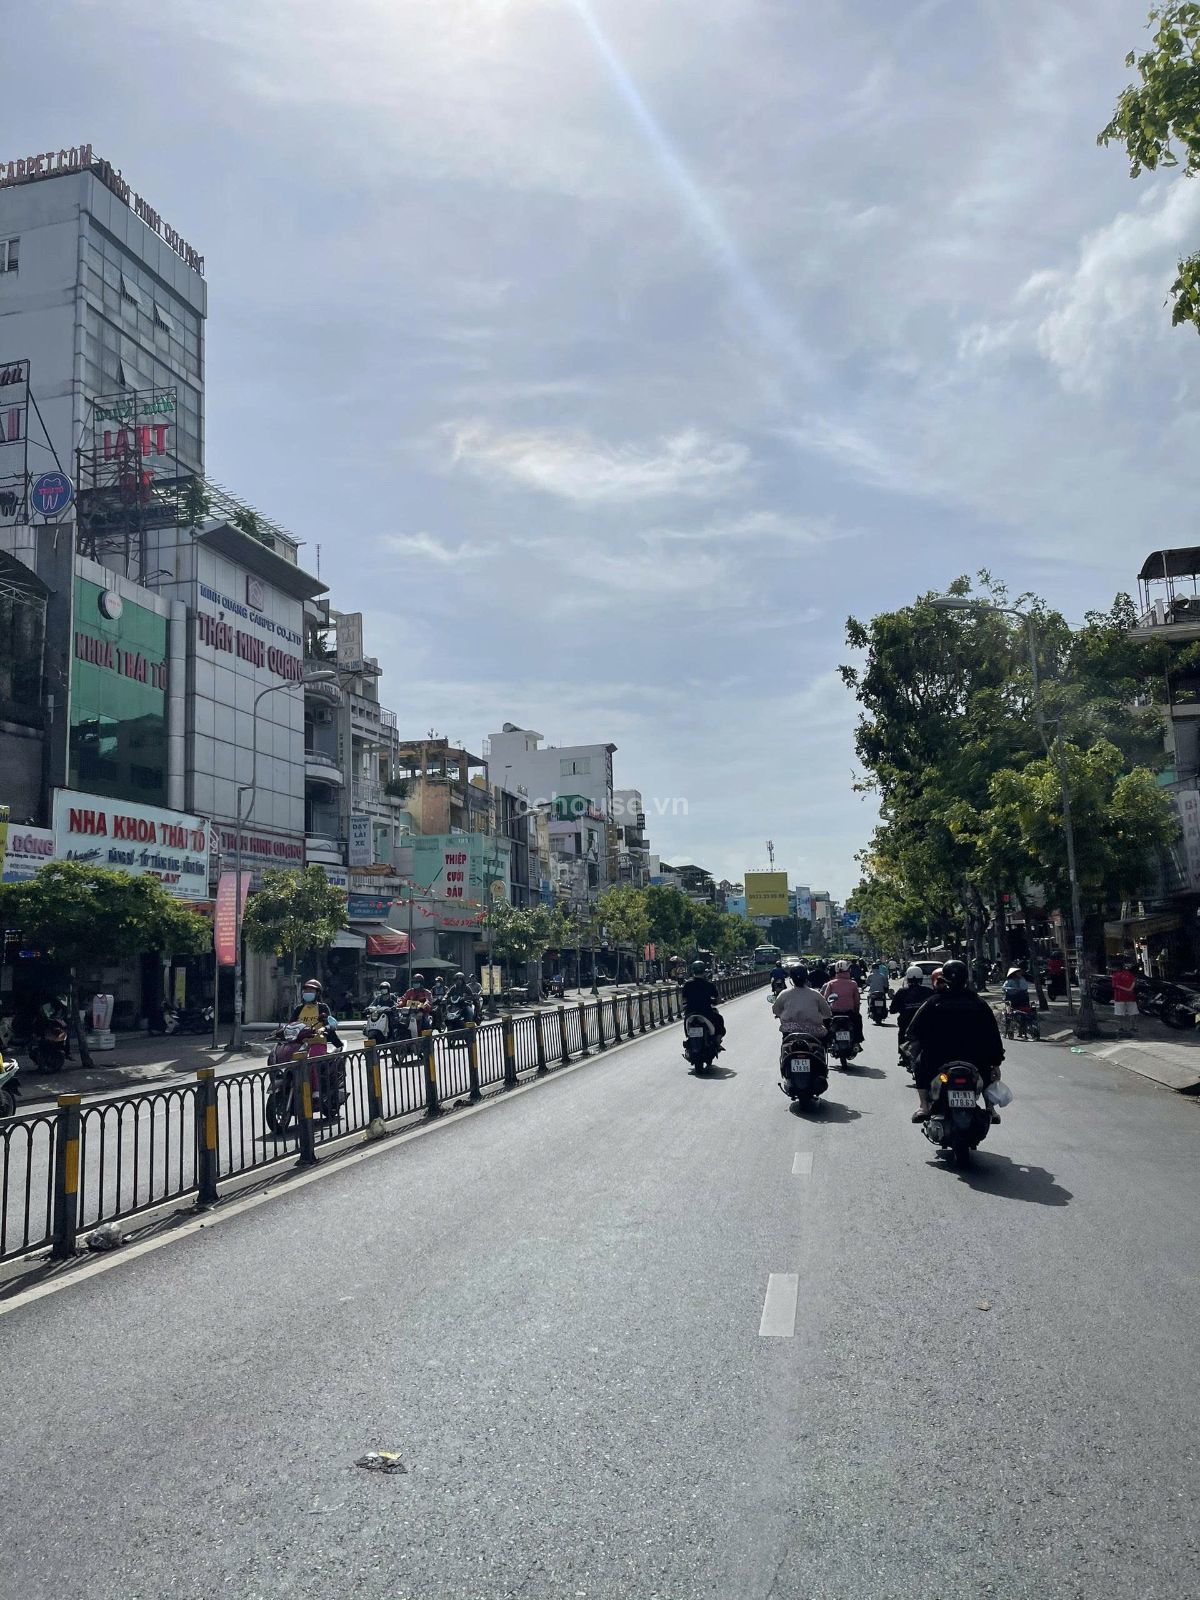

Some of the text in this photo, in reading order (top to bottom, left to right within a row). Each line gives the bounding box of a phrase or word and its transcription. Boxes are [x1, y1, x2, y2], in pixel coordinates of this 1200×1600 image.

[200, 585, 221, 604] MINH
[221, 596, 248, 619] QUANG
[249, 611, 275, 633] CARPET
[198, 611, 304, 682] THẢM MINH QUANG
[69, 808, 108, 836] NHA
[112, 815, 157, 844] KHOA
[160, 821, 188, 849] THÁI
